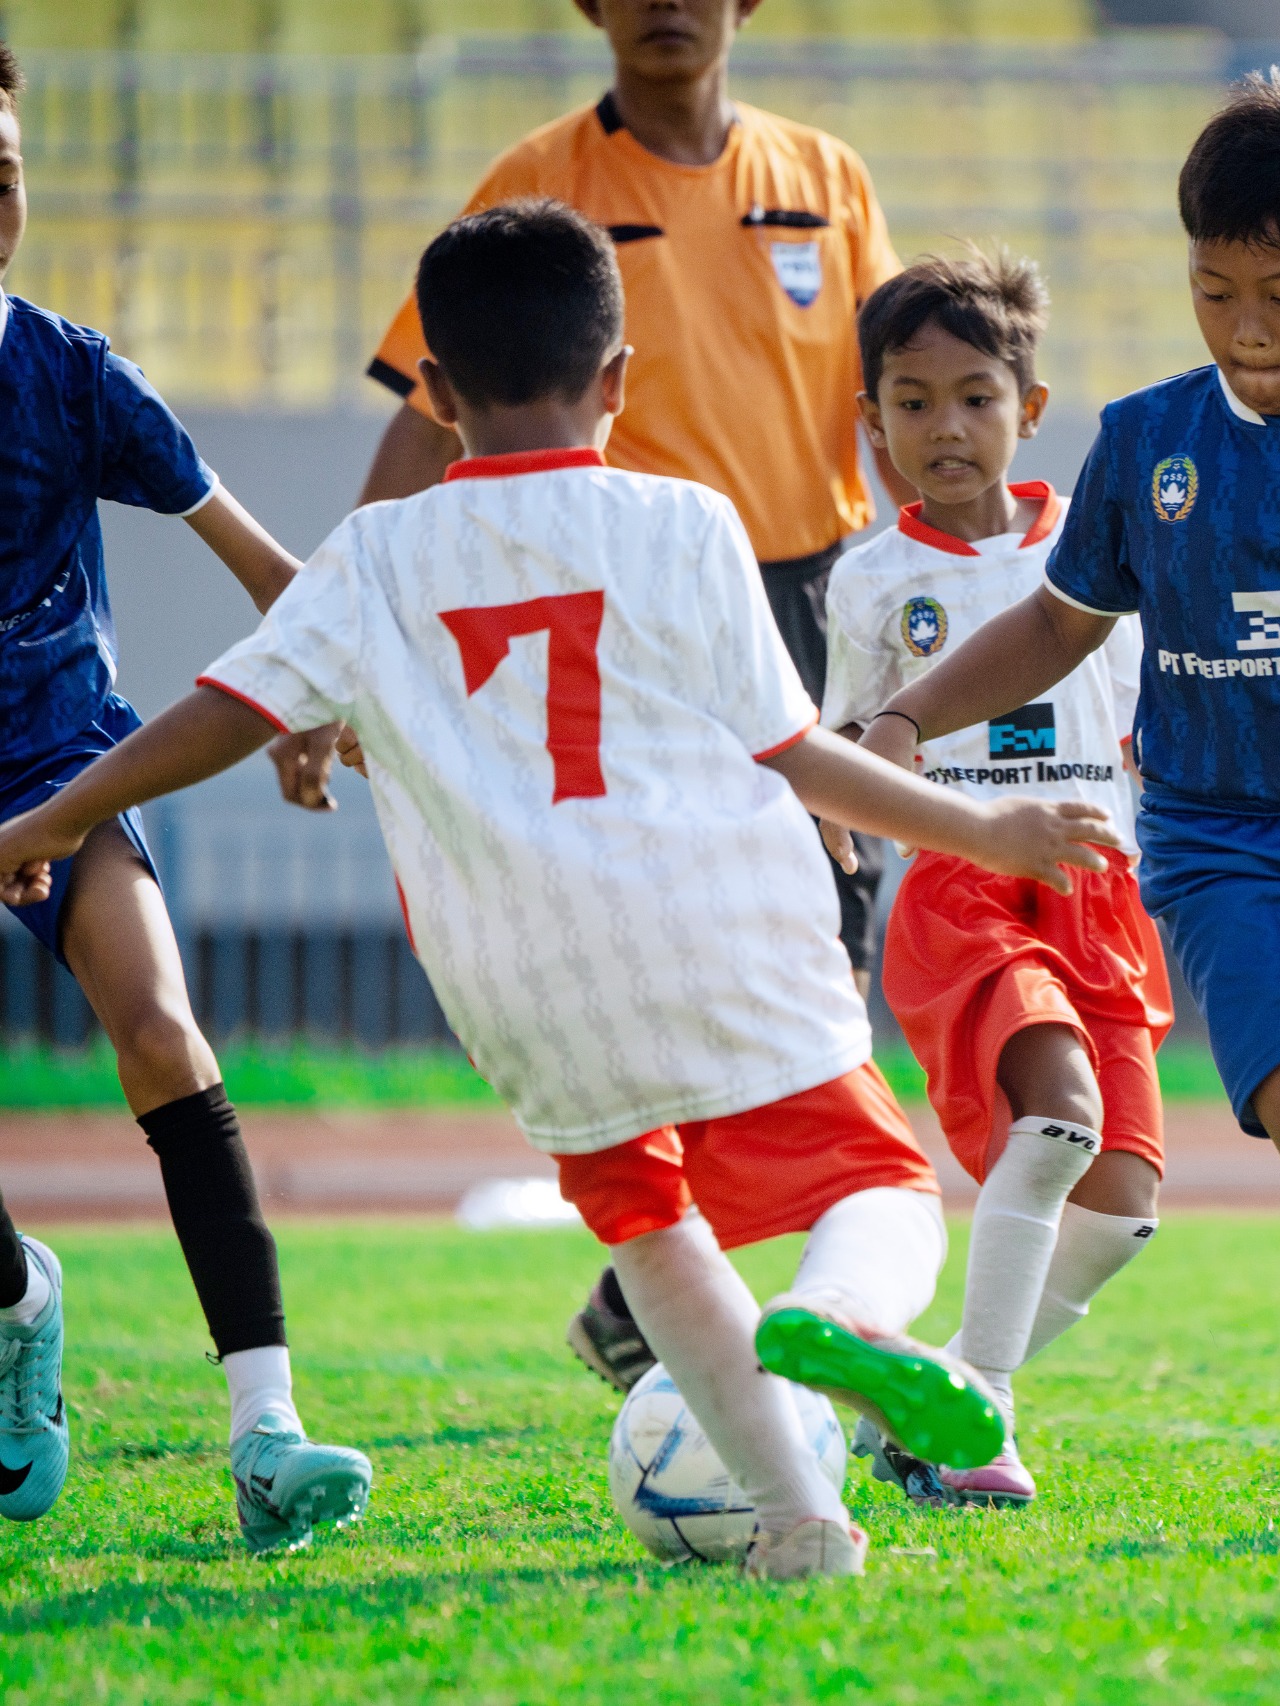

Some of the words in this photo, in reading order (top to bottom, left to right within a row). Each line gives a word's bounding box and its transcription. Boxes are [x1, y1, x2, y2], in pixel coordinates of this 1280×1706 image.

[1162, 473, 1187, 483] PSSI
[1158, 649, 1181, 675] PT
[436, 590, 607, 807] 7
[936, 766, 1032, 785] REEPORT
[1037, 761, 1113, 782] INDOESA
